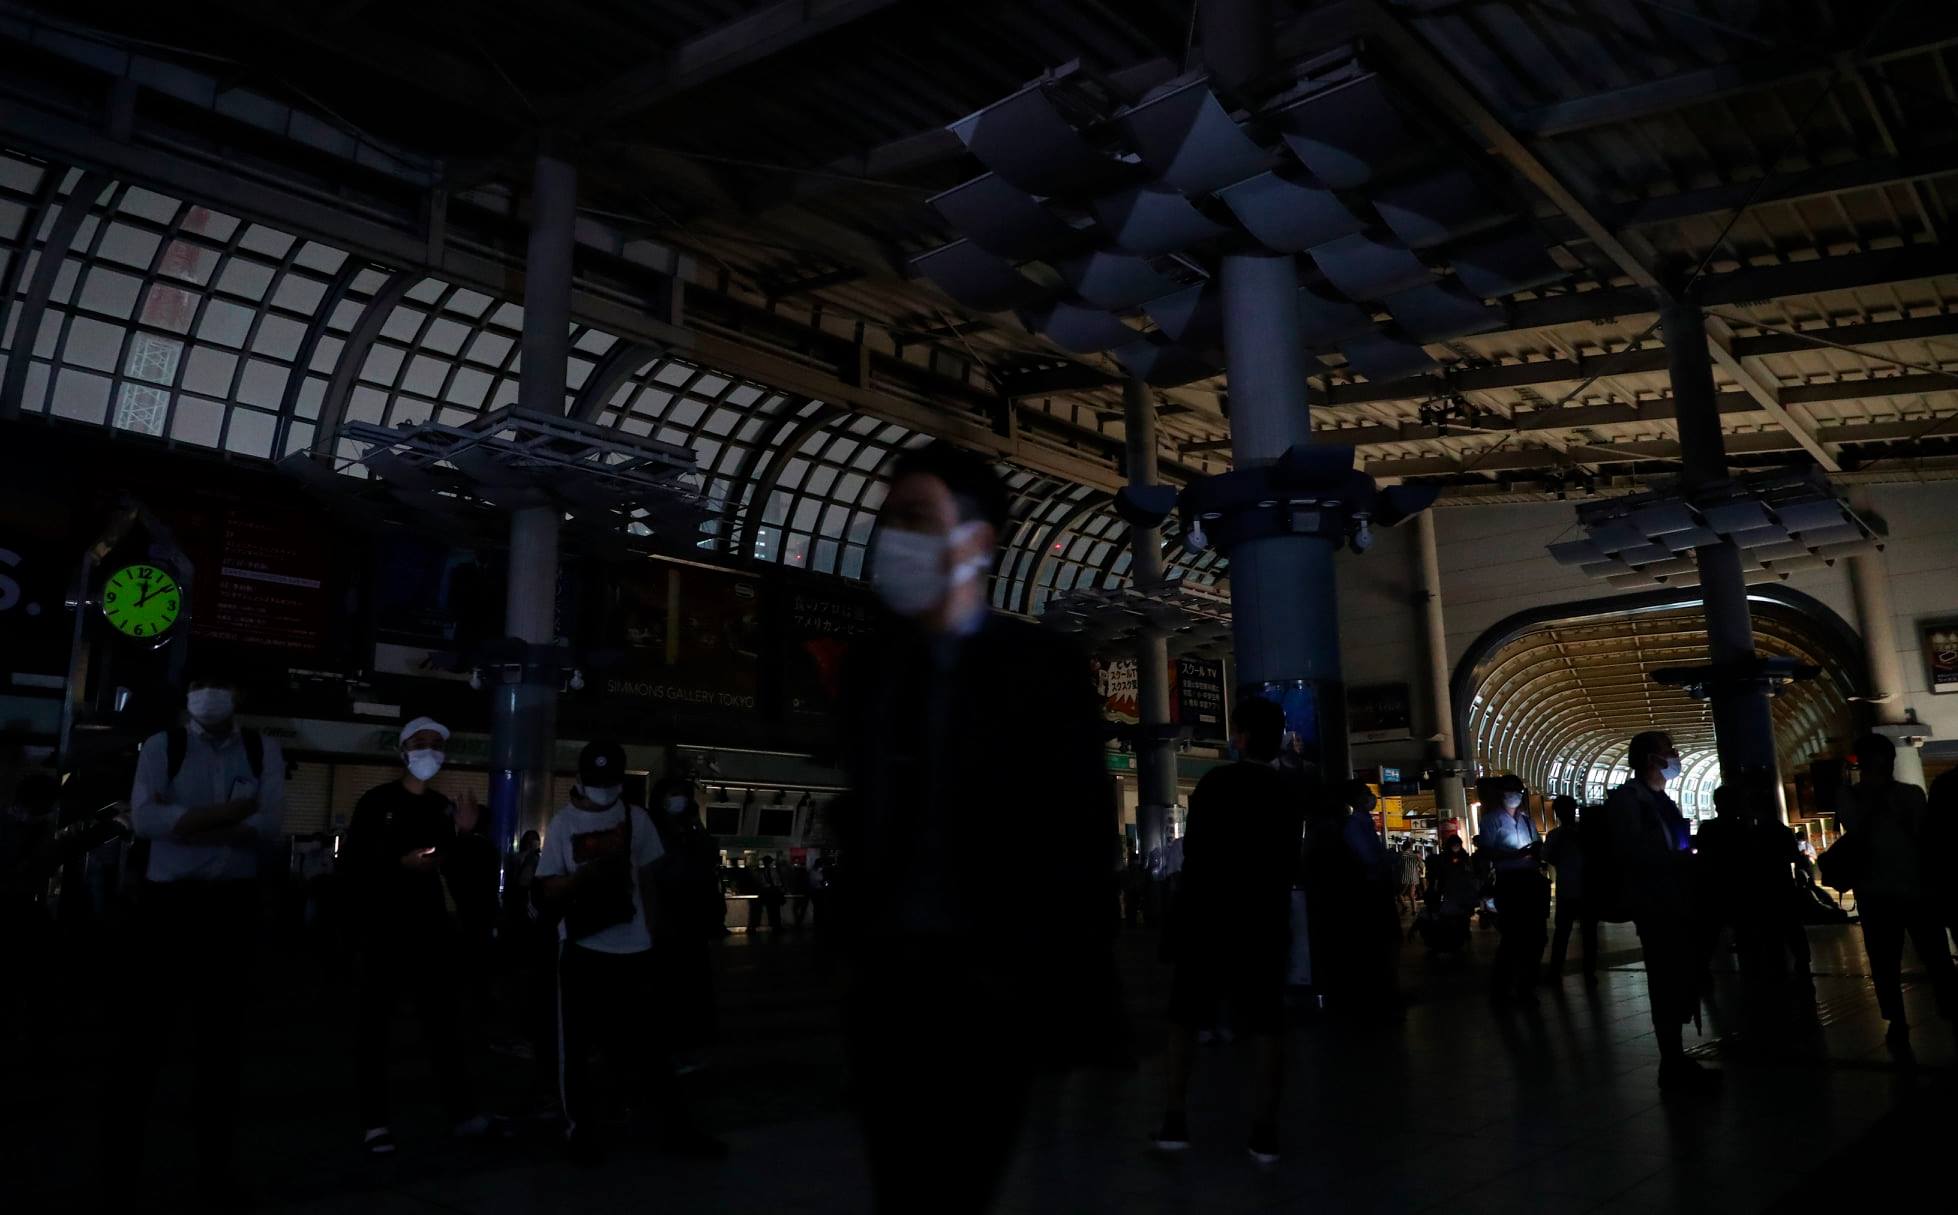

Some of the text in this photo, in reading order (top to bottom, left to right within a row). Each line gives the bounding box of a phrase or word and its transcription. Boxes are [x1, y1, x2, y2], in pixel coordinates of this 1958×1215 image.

[138, 567, 153, 580] 12
[106, 592, 116, 603] 9
[167, 600, 176, 611] 3
[134, 624, 143, 635] 6
[607, 679, 754, 709] SIMMONS GALLERY TOKYO
